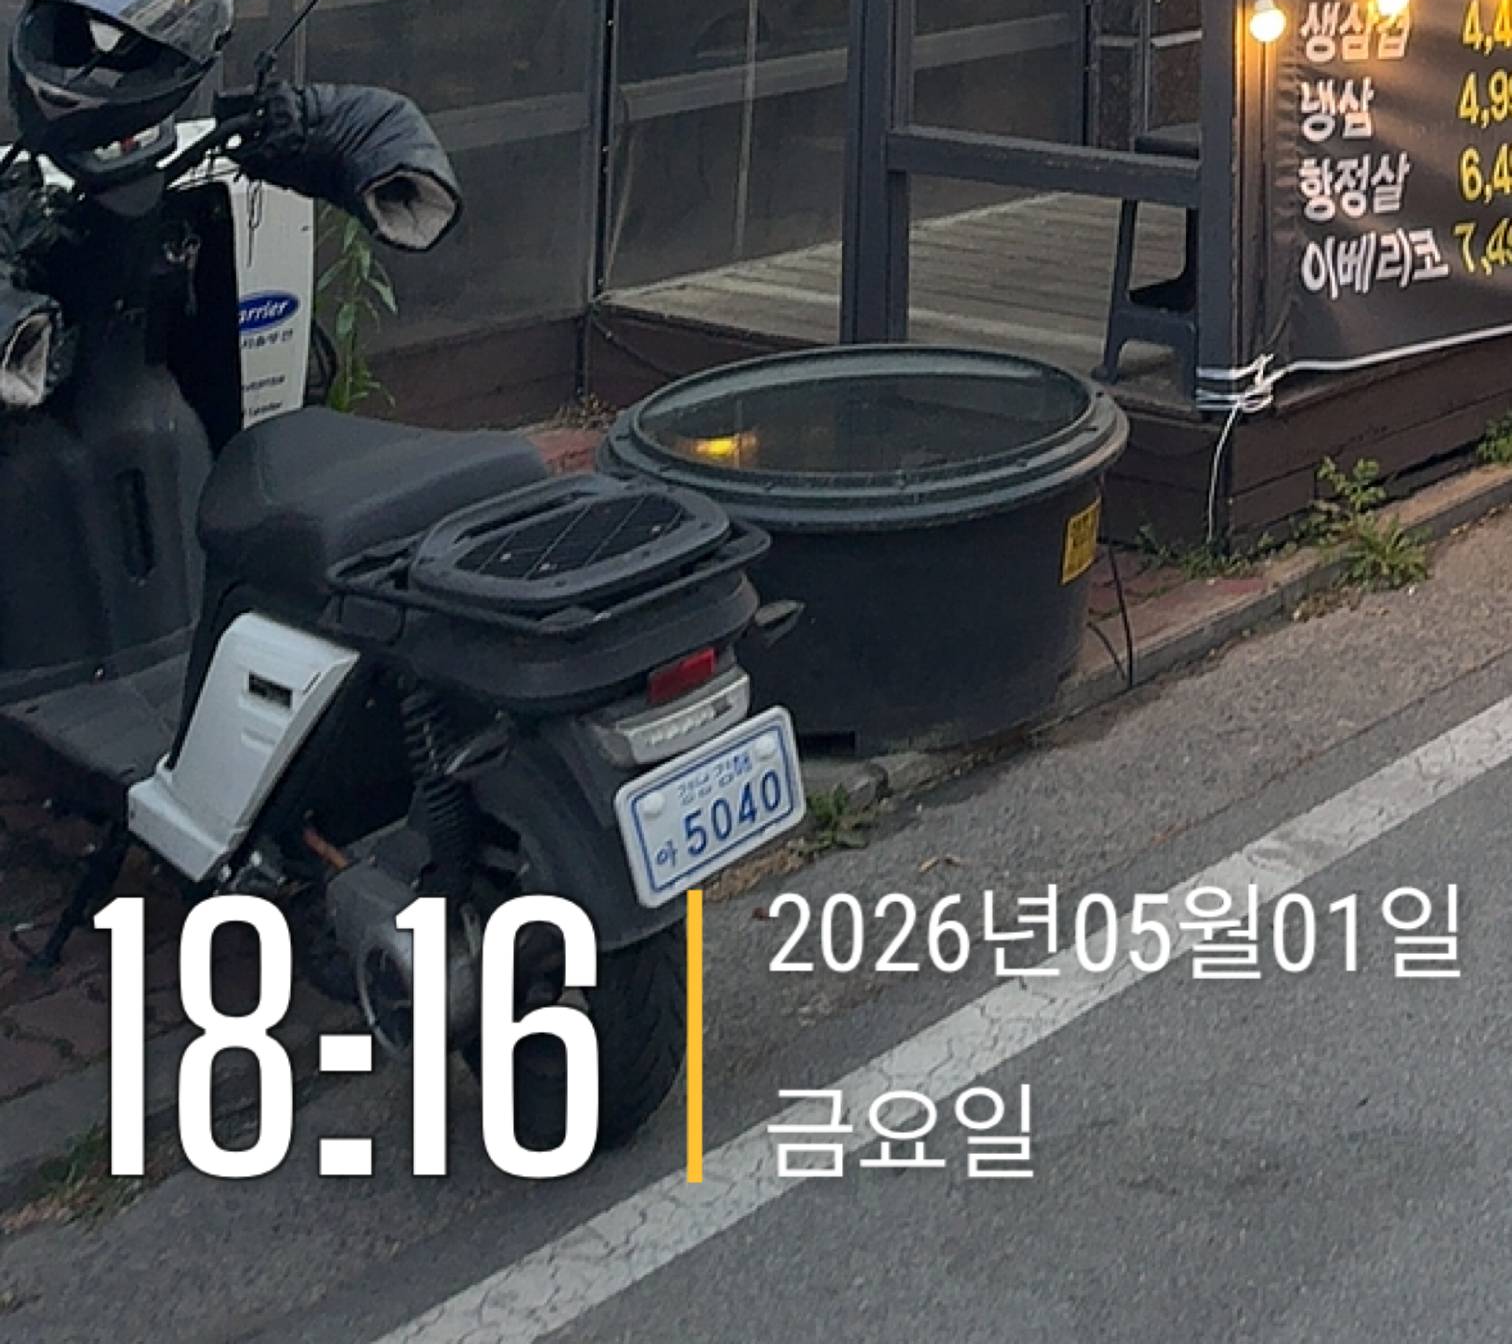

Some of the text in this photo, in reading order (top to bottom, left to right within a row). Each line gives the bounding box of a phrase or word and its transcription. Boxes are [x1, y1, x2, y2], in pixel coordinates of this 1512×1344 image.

[1301, 77, 1374, 143] 냉삼
[1300, 151, 1410, 223] 항정살
[1301, 229, 1450, 299] 이베리코
[239, 299, 290, 325] arrier
[655, 770, 782, 868] 아 5040
